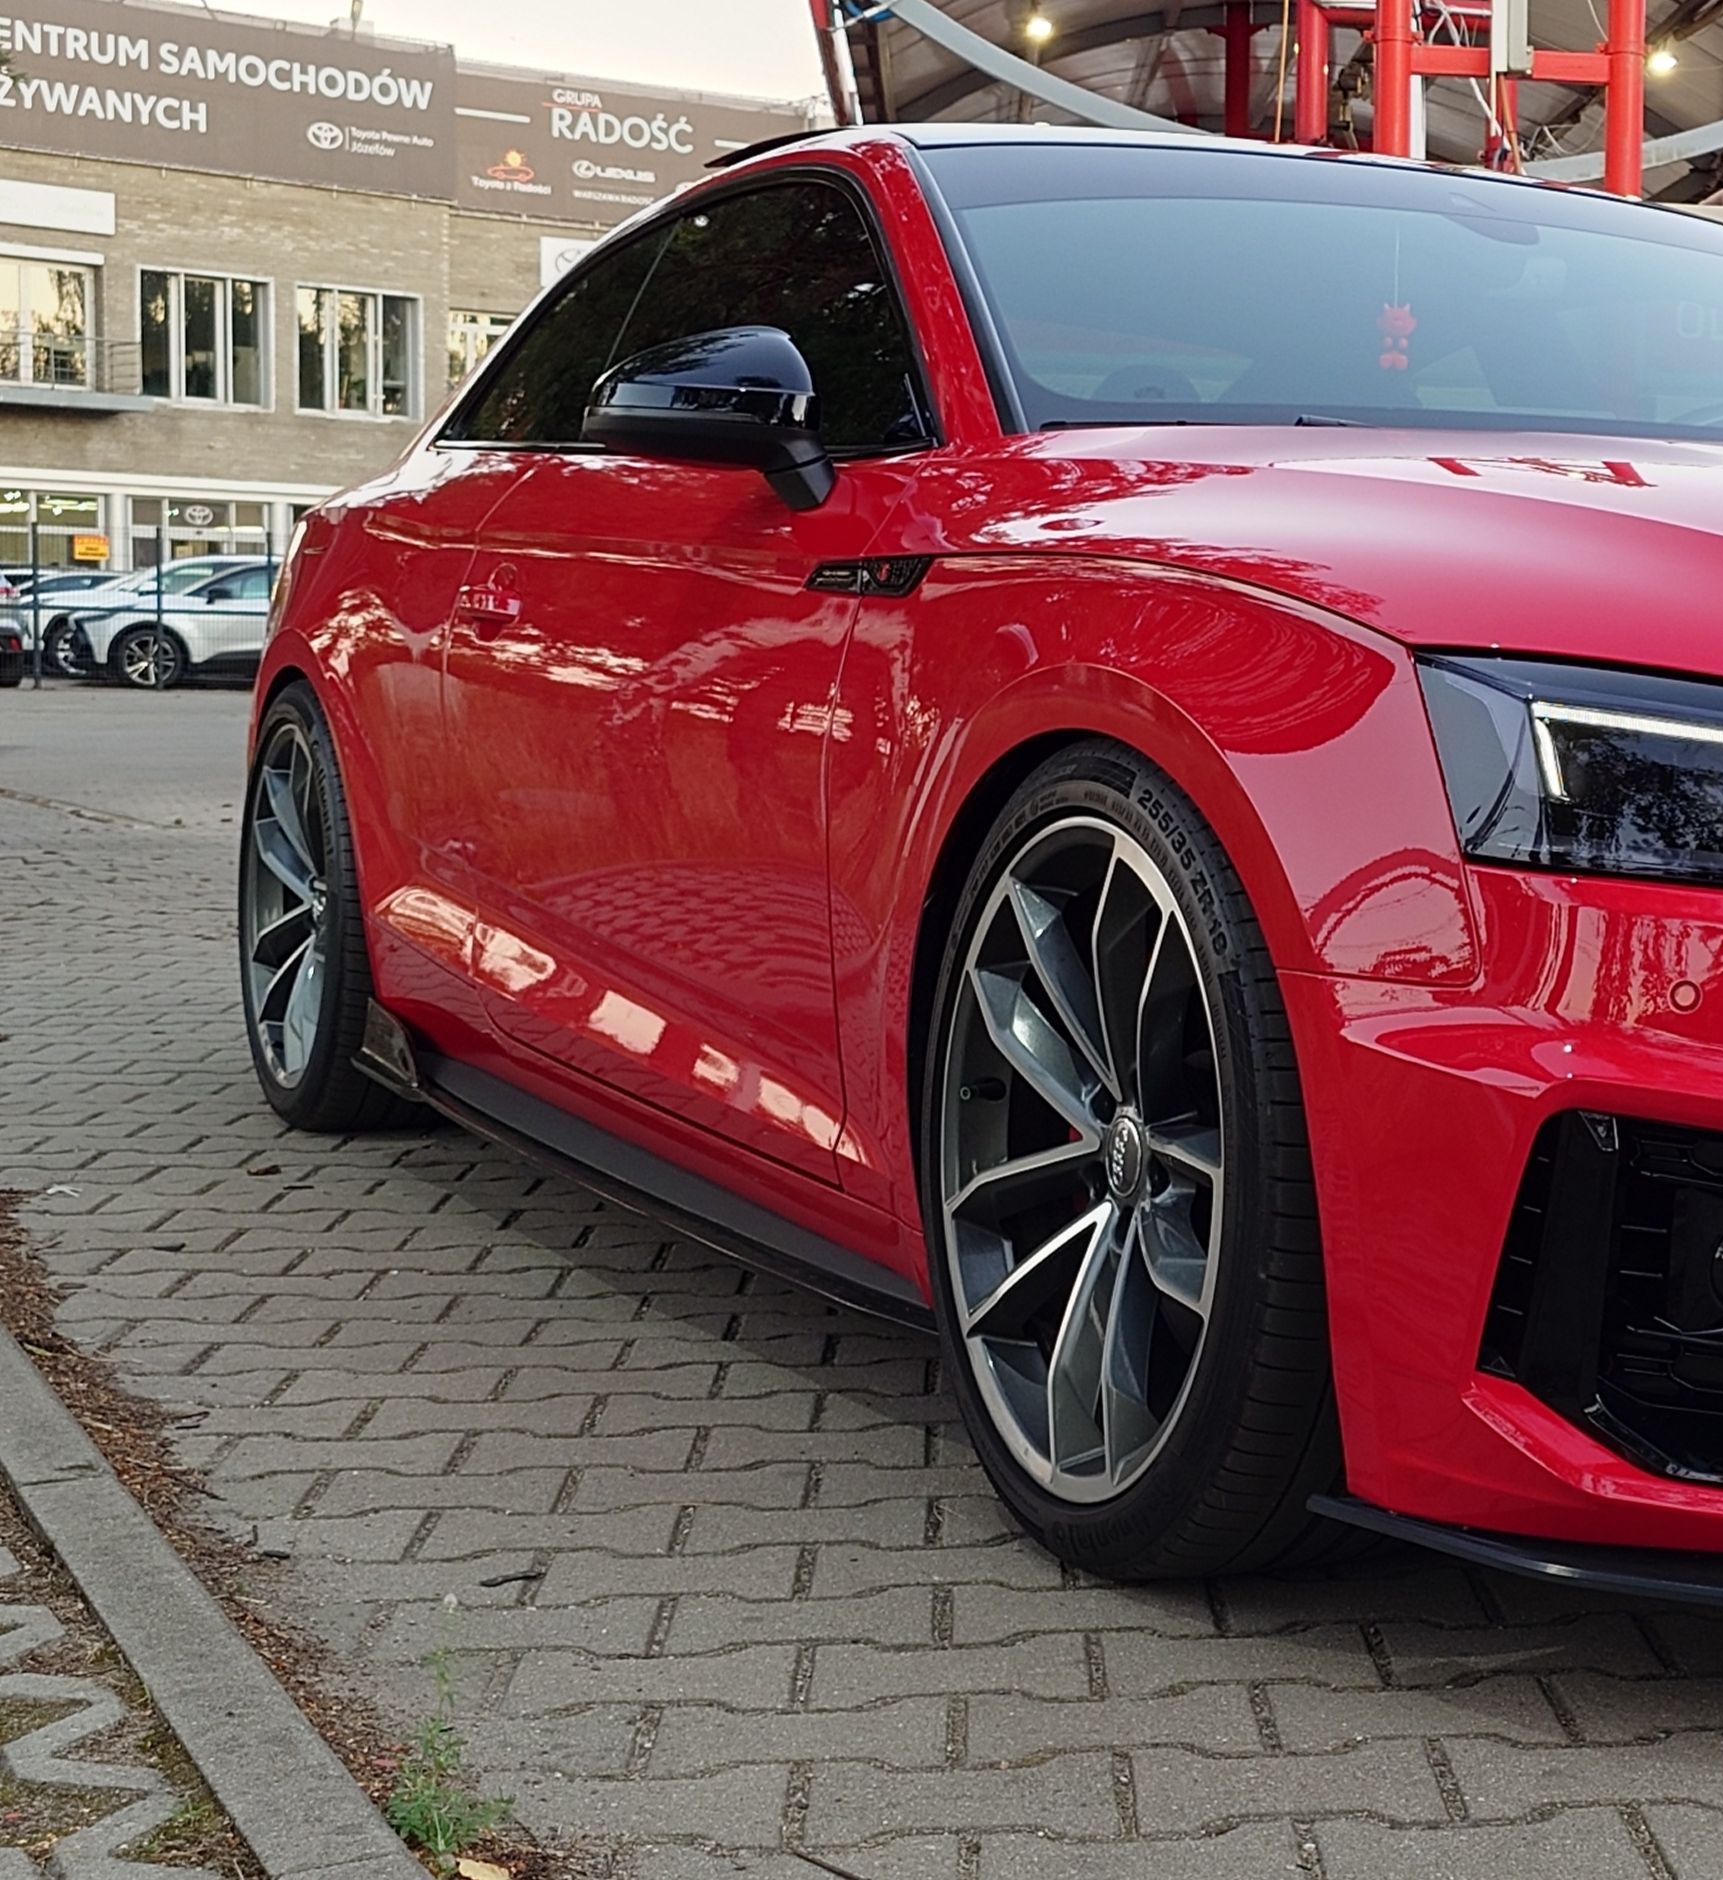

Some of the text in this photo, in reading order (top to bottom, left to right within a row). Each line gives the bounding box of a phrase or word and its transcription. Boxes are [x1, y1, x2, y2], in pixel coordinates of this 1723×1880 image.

[159, 42, 433, 110] SAMOCHODÓW
[552, 88, 602, 108] GRUPA
[552, 106, 694, 154] RADOŚĆ
[471, 175, 504, 191] Toyota
[1137, 790, 1196, 871] 255/35
